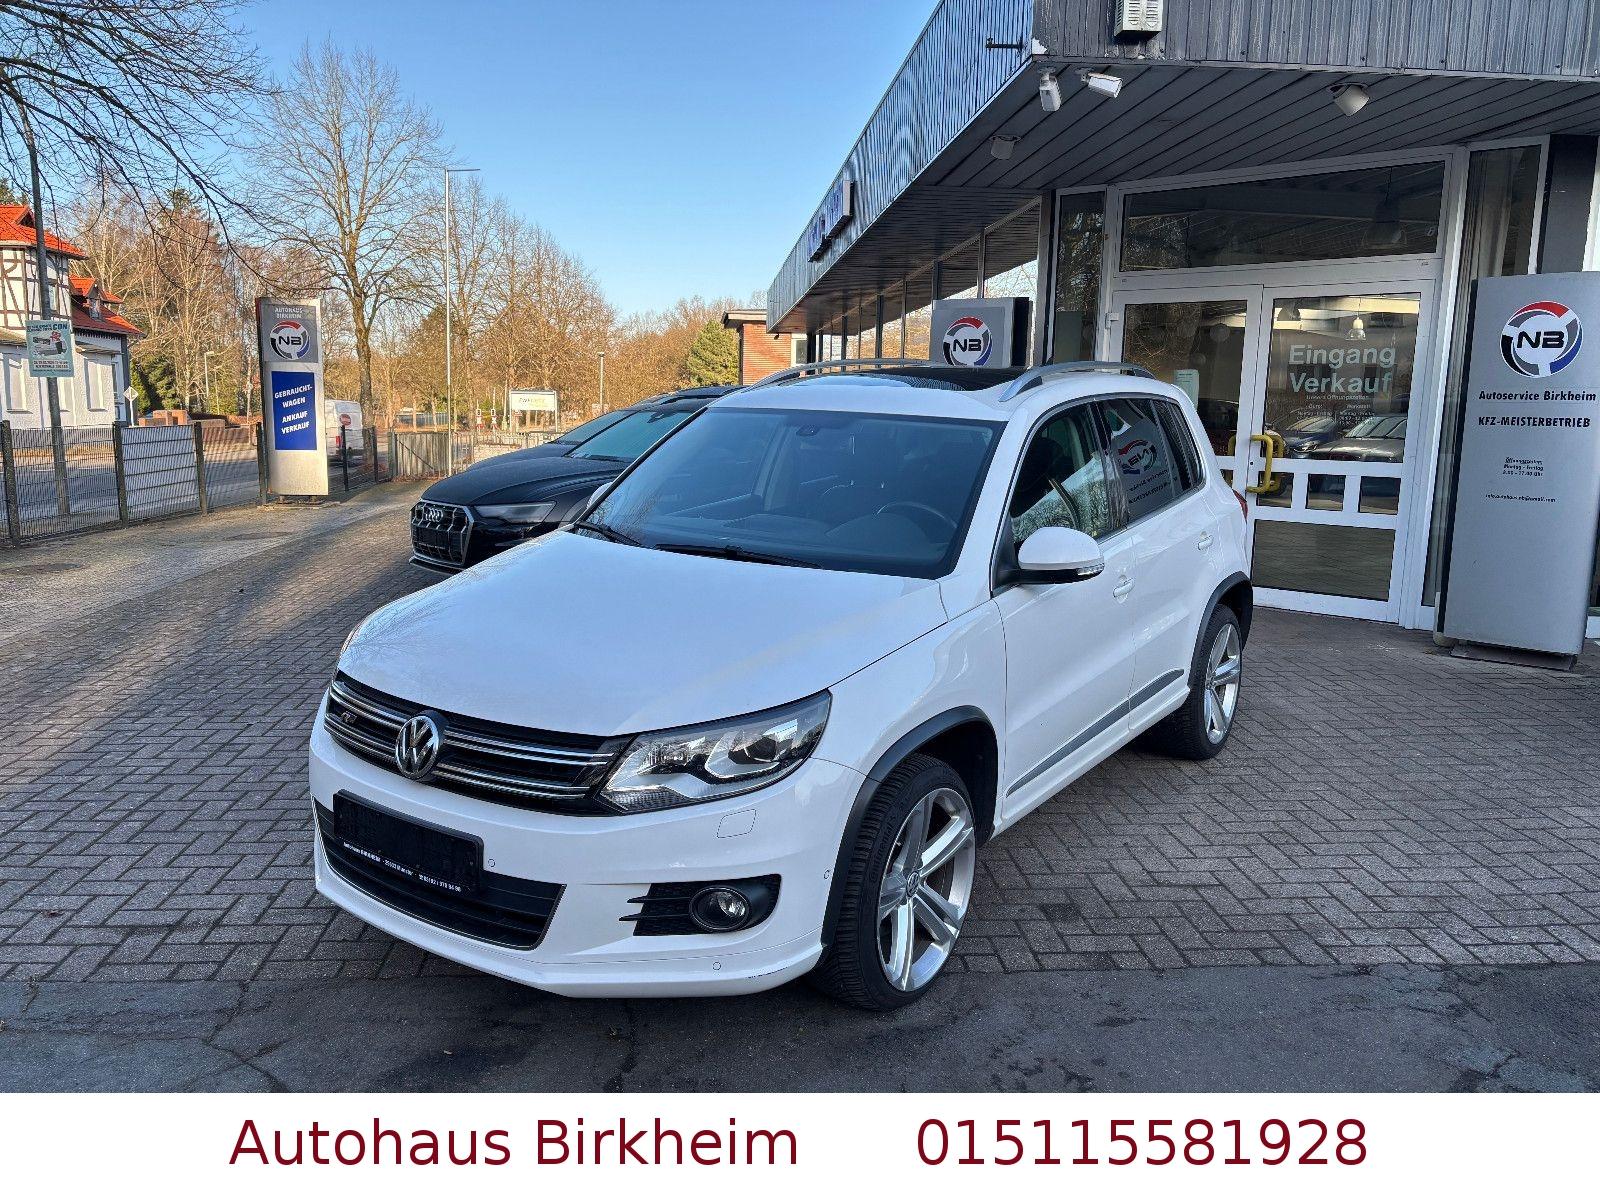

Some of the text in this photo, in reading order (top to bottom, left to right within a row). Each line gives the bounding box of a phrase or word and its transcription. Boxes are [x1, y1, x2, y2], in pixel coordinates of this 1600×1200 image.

[279, 335, 302, 346] NB
[952, 338, 982, 353] NB
[1516, 331, 1565, 349] NB
[1288, 344, 1396, 369] Eingang
[1289, 371, 1393, 393] Verkauf
[274, 384, 313, 399] GEBRAUCHT-
[1478, 390, 1597, 401] Autoservice Birkheim
[282, 396, 306, 408] WAGEN
[282, 410, 308, 423] ANKAUF
[1478, 416, 1591, 428] KFZ-MEISTERBETRIEB
[281, 421, 310, 434] VERKAUF
